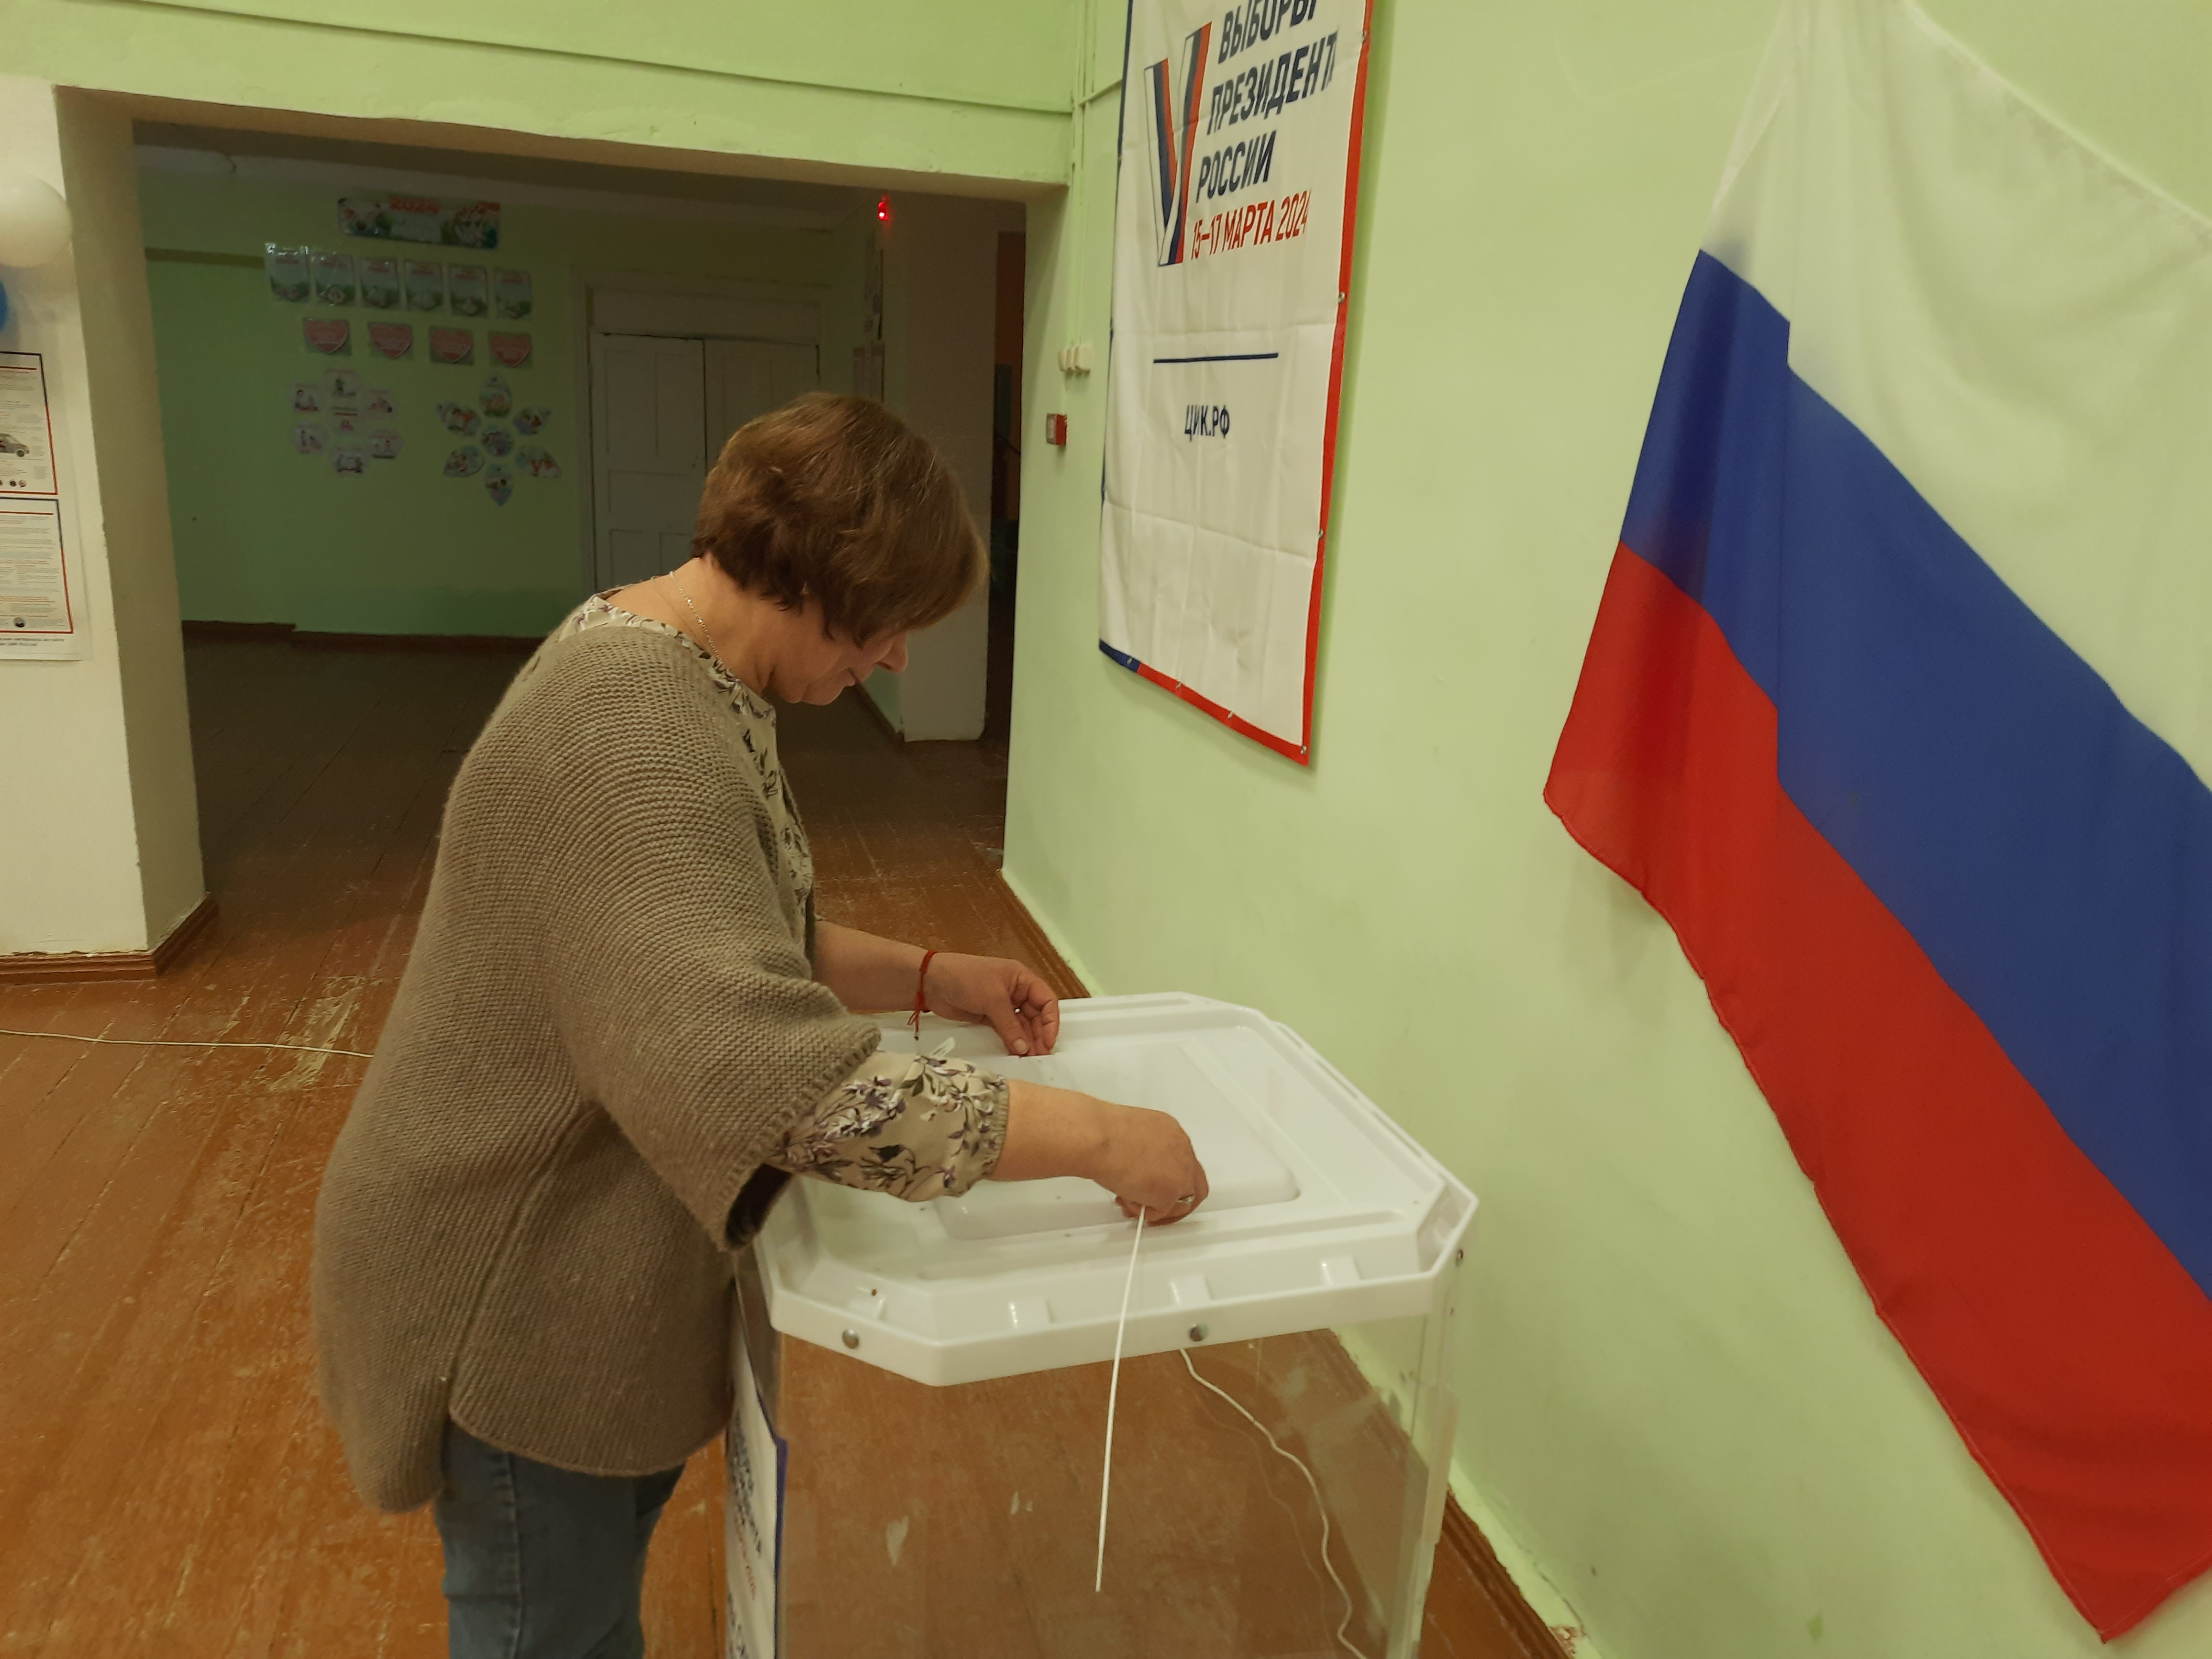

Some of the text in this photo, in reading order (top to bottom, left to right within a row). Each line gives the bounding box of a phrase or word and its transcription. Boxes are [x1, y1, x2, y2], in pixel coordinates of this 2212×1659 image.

[1218, 0, 1317, 64] ВЫБОРЫ
[1206, 29, 1338, 135] ПРЕЗИДЕНТ
[1196, 130, 1277, 203] РОССИИ
[1221, 199, 1275, 253] МАРТА
[1275, 189, 1312, 242] 2024
[1184, 405, 1230, 442] ЦИК.РФ
